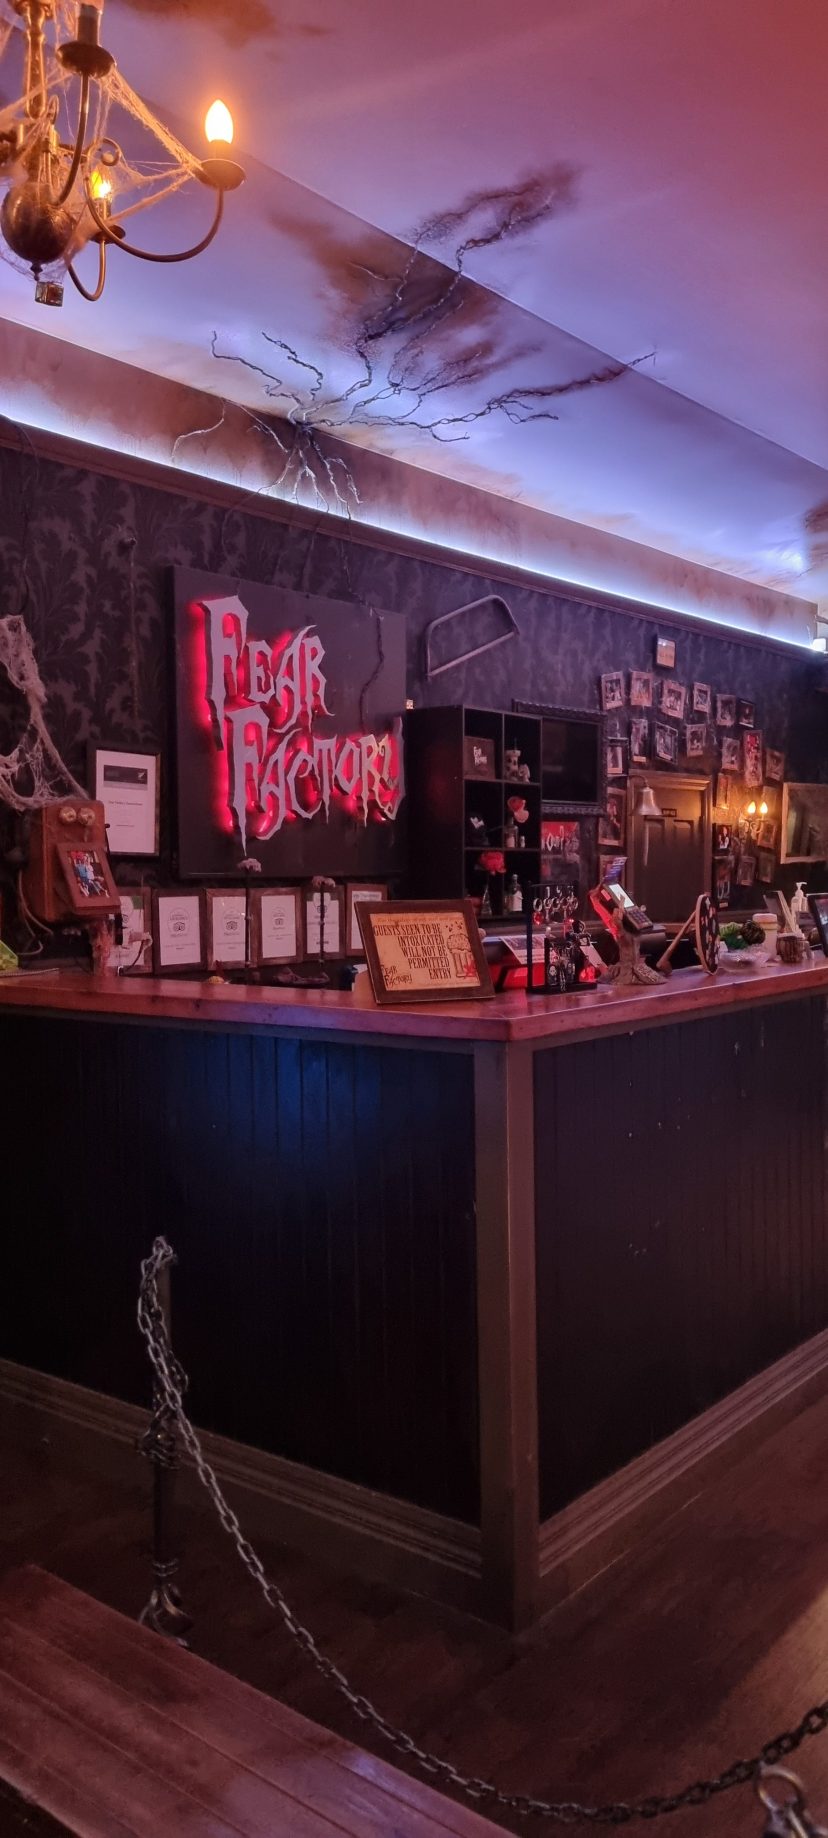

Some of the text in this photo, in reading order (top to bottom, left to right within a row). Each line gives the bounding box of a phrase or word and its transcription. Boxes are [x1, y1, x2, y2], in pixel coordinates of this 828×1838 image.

[201, 595, 335, 749] FEAR
[226, 706, 405, 856] FACTORY
[374, 923, 443, 937] GUESTS SEEN TO BE
[398, 934, 445, 946] INTOXICATED
[402, 945, 448, 957] WILL NOT BE
[408, 957, 450, 969] PERMITTED
[428, 968, 452, 980] ENTRY
